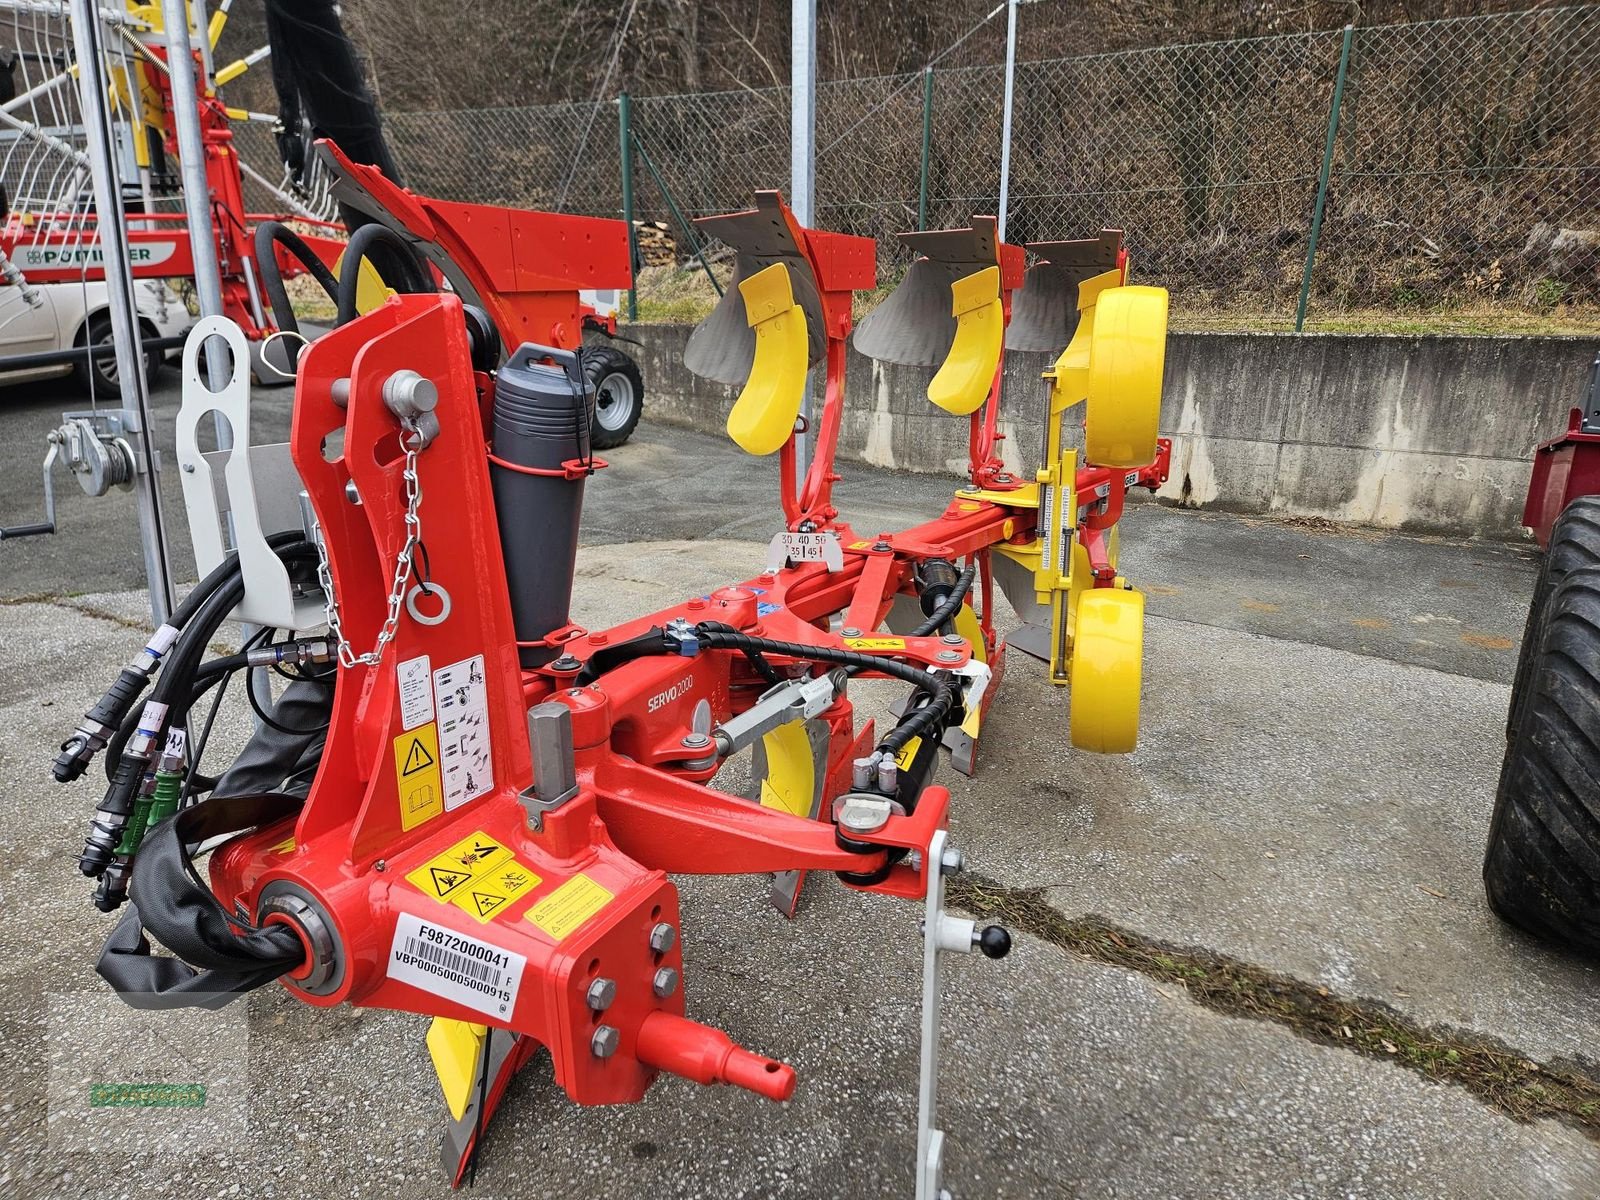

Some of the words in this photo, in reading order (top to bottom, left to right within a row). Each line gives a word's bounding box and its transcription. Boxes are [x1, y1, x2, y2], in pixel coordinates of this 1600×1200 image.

[782, 535, 792, 544] 30
[799, 535, 809, 544] 40
[815, 535, 826, 544] 50
[791, 547, 800, 555] 35
[808, 547, 817, 555] 45
[648, 686, 677, 713] SERVO
[677, 674, 693, 697] 2000
[418, 925, 510, 969] F9872000041
[395, 951, 511, 1002] VBP00050005000915
[506, 977, 512, 986] F
